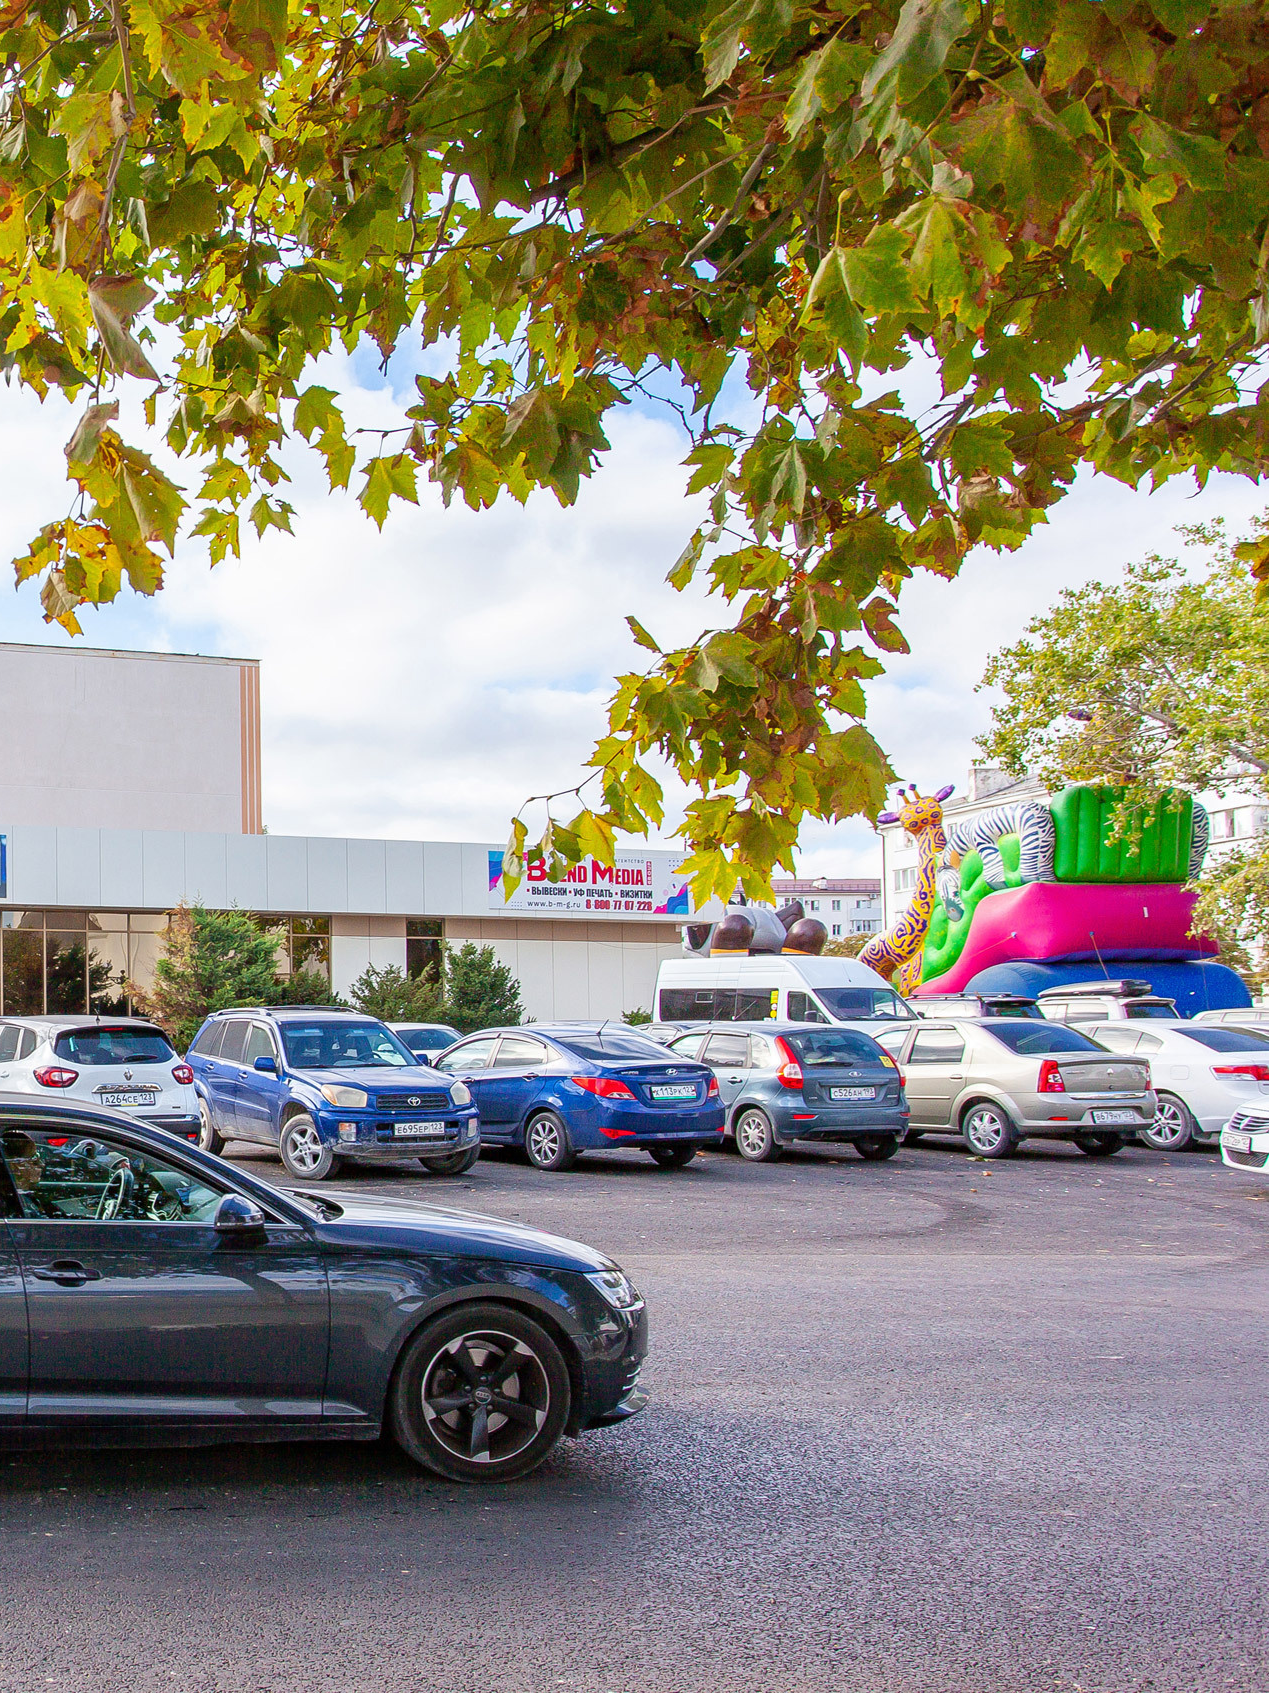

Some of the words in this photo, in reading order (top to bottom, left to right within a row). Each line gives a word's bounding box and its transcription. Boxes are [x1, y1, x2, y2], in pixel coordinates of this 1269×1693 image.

[527, 857, 588, 883] BND
[531, 886, 568, 896] ВЫВЕСКИ
[573, 888, 585, 897] УФ
[586, 888, 613, 898] ПЕЧАТЬ
[619, 889, 653, 899] ВИЗИТКИ
[527, 900, 581, 909] www.b-m-g.ru
[105, 1094, 138, 1104] А264СЕ
[139, 1093, 152, 1101] 123
